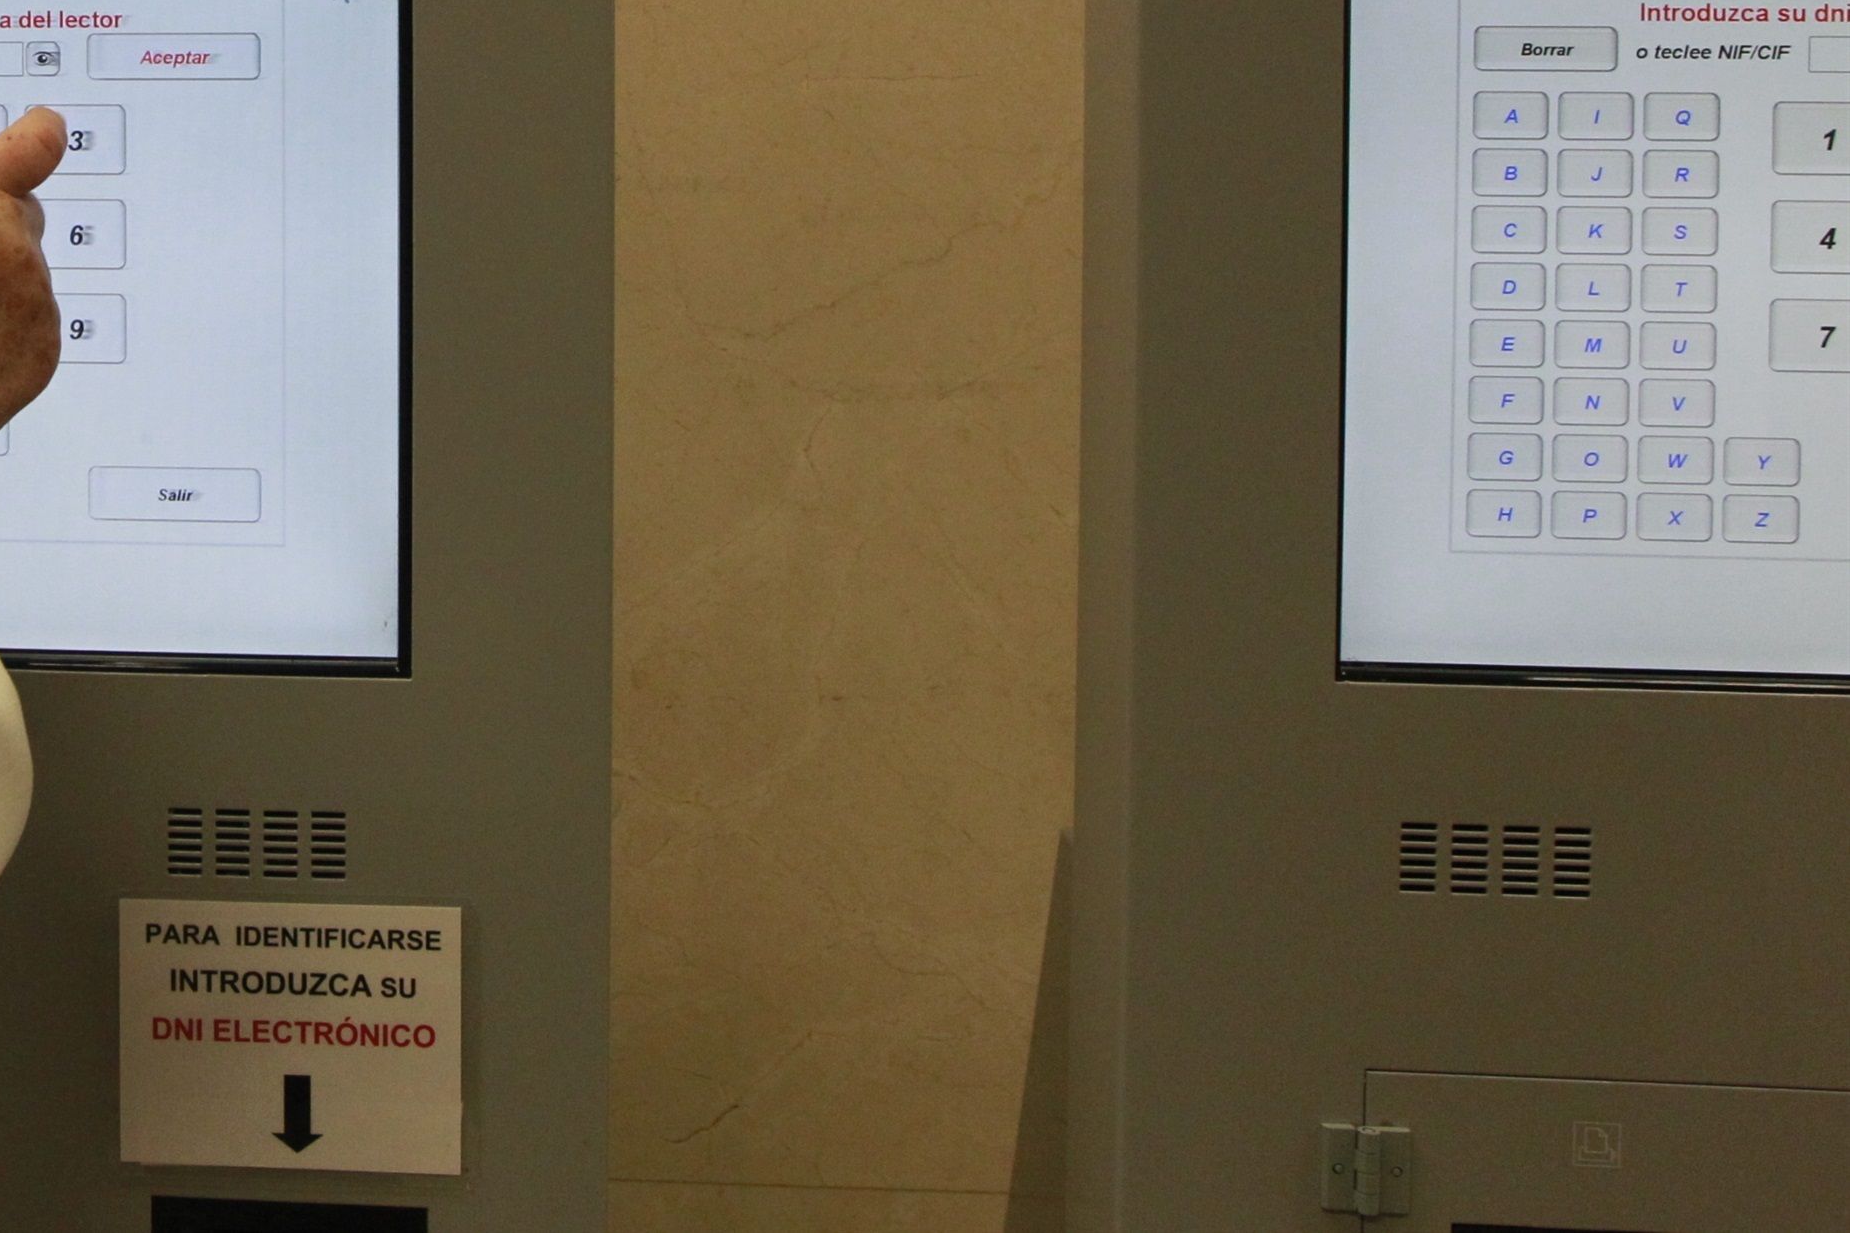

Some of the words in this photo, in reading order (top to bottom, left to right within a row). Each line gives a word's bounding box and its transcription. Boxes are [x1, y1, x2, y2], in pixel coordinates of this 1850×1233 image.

[18, 11, 52, 29] del
[59, 11, 123, 29] lector
[1641, 3, 1768, 22] Introduzca
[1777, 5, 1807, 23] su
[1521, 43, 1574, 56] Borrar
[1635, 45, 1649, 60] o
[1654, 44, 1712, 61] teclee
[1717, 44, 1792, 61] NIF/CIF
[140, 49, 211, 67] Aceptar
[1504, 109, 1518, 123] A
[1676, 110, 1691, 126] Q
[68, 129, 84, 151] 3
[1824, 129, 1836, 150] 1
[1505, 166, 1517, 180] B
[1591, 167, 1602, 181] J
[1675, 168, 1689, 181] R
[70, 225, 83, 245] 6
[1504, 223, 1517, 237] C
[1589, 224, 1603, 238] K
[1674, 225, 1687, 239] S
[1820, 228, 1836, 249] 4
[1502, 280, 1516, 294] D
[1588, 282, 1599, 295] L
[1676, 282, 1688, 296] T
[70, 320, 84, 339] 9
[1501, 337, 1515, 351] E
[1821, 326, 1836, 348] 7
[1585, 338, 1602, 352] M
[1673, 340, 1687, 354] U
[1501, 394, 1515, 408] F
[1585, 395, 1600, 409] N
[1673, 397, 1686, 411] V
[1499, 451, 1513, 465] G
[1584, 452, 1599, 466] O
[1669, 454, 1688, 468] W
[1758, 456, 1771, 469] Y
[157, 488, 194, 503] Salir
[1498, 508, 1513, 521] H
[1583, 509, 1597, 523] P
[1668, 511, 1683, 525] X
[1755, 513, 1769, 527] Z
[146, 923, 220, 945] PARA
[236, 926, 441, 951] IDENTIFICARSE
[170, 968, 371, 997] INTRODUZCA
[381, 977, 416, 998] SU
[152, 1017, 202, 1041] DNI
[213, 1017, 435, 1048] ELECTRÓNICO
